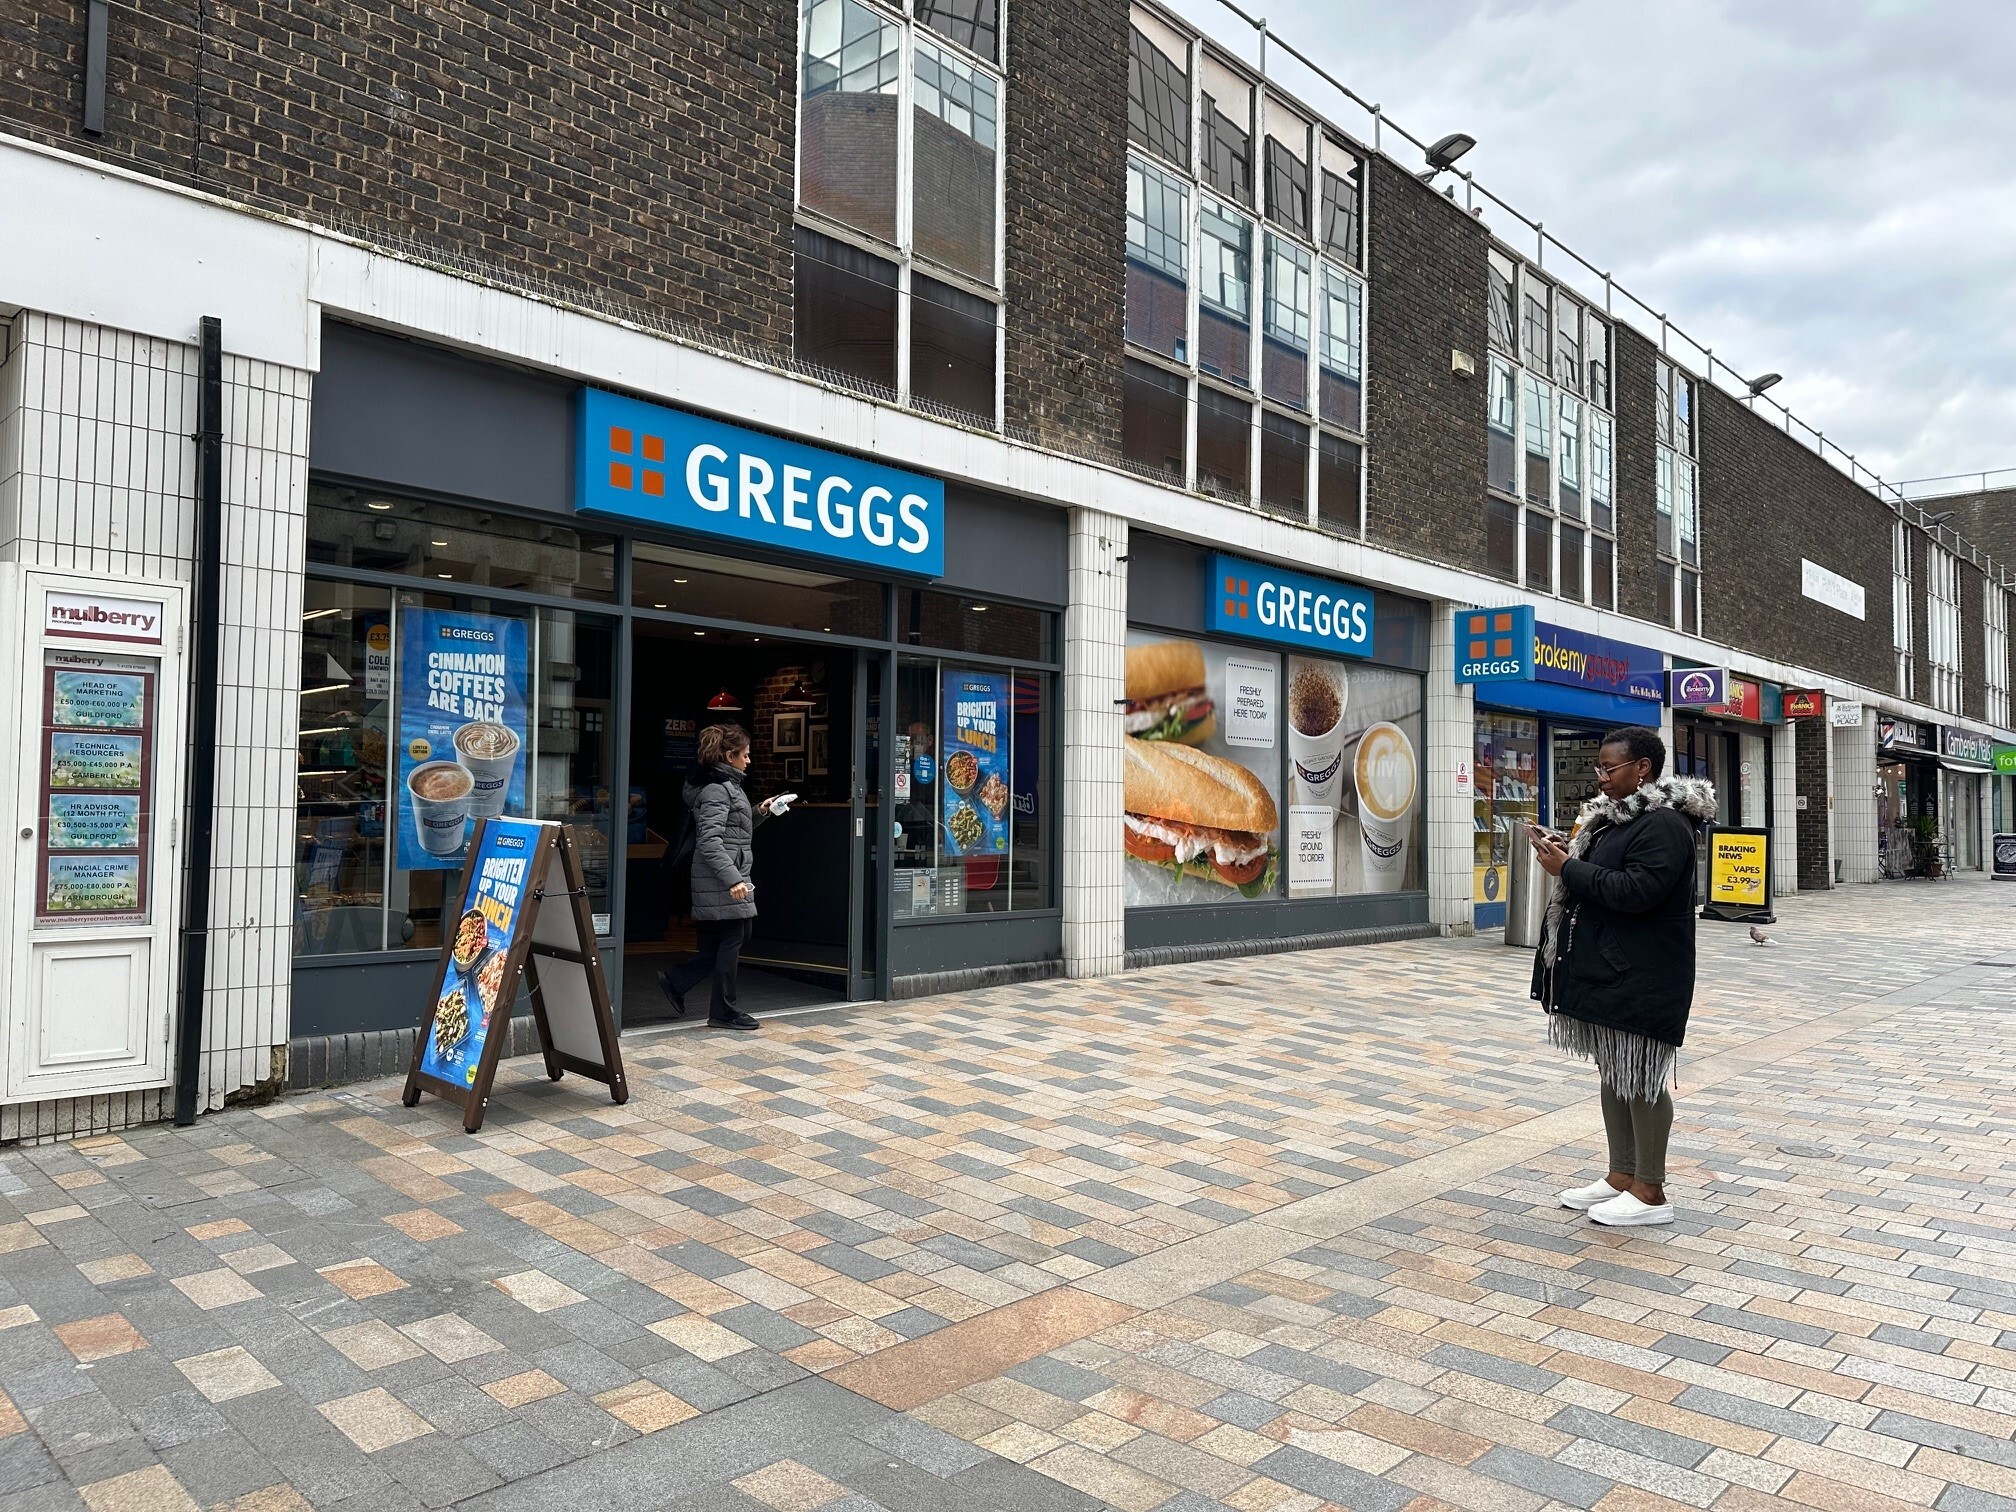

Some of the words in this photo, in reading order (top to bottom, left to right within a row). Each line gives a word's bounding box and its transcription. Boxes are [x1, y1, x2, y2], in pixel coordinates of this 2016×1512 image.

[685, 444, 930, 554] GREGGS
[1256, 581, 1367, 643] GREGGS
[52, 605, 156, 631] mulberry
[452, 629, 494, 641] GREGGS
[55, 655, 104, 667] mulberry
[368, 655, 390, 666] COLD
[428, 652, 506, 676] CINNAMON
[1462, 660, 1520, 677] GREGGS
[82, 681, 105, 689] HEAD
[428, 669, 506, 704] COFFEES
[968, 684, 991, 692] GREGGS
[1239, 685, 1262, 696] FRESHLY
[76, 689, 124, 697] MARKETING
[428, 690, 460, 715] ARE
[464, 697, 505, 725] BACK
[1236, 697, 1264, 708] PREPARED
[75, 711, 122, 719] GUILDFORD
[957, 701, 997, 720] BRIGHTEN
[1233, 708, 1248, 719] HERE
[1249, 709, 1267, 720] TODAY
[665, 719, 696, 731] ZERO
[957, 716, 970, 729] UP
[972, 718, 996, 735] YOUR
[957, 727, 997, 753] LUNCH
[75, 742, 120, 750] TECHNICAL
[1946, 730, 1979, 759] Camberley
[1979, 737, 1991, 762] Nails
[69, 749, 125, 757] RESOURCERS
[71, 771, 121, 779] CAMBERLEY
[476, 780, 503, 789] REGGS
[84, 803, 120, 811] ADVISOR
[63, 810, 75, 818] (12
[432, 815, 465, 828] GREGGS
[1301, 831, 1322, 840] FRESHLY
[502, 837, 524, 848] GREGGS
[1300, 842, 1323, 851] GROUND
[1366, 838, 1401, 856] GREGGS
[1718, 844, 1756, 853] BRAKING
[1298, 853, 1306, 863] TO
[1307, 853, 1325, 863] ORDER
[1718, 852, 1743, 860] NEWS
[482, 857, 527, 886] BRIGHTEN
[1733, 865, 1760, 874] VAPES
[1727, 876, 1751, 884] £3.99
[62, 893, 125, 901] FARNBOROUGH
[479, 876, 492, 894] UP
[493, 881, 519, 907] YOUR
[474, 891, 514, 934] LUNCH
[39, 914, 142, 924] www.mulberryrecruitment.co.uk
